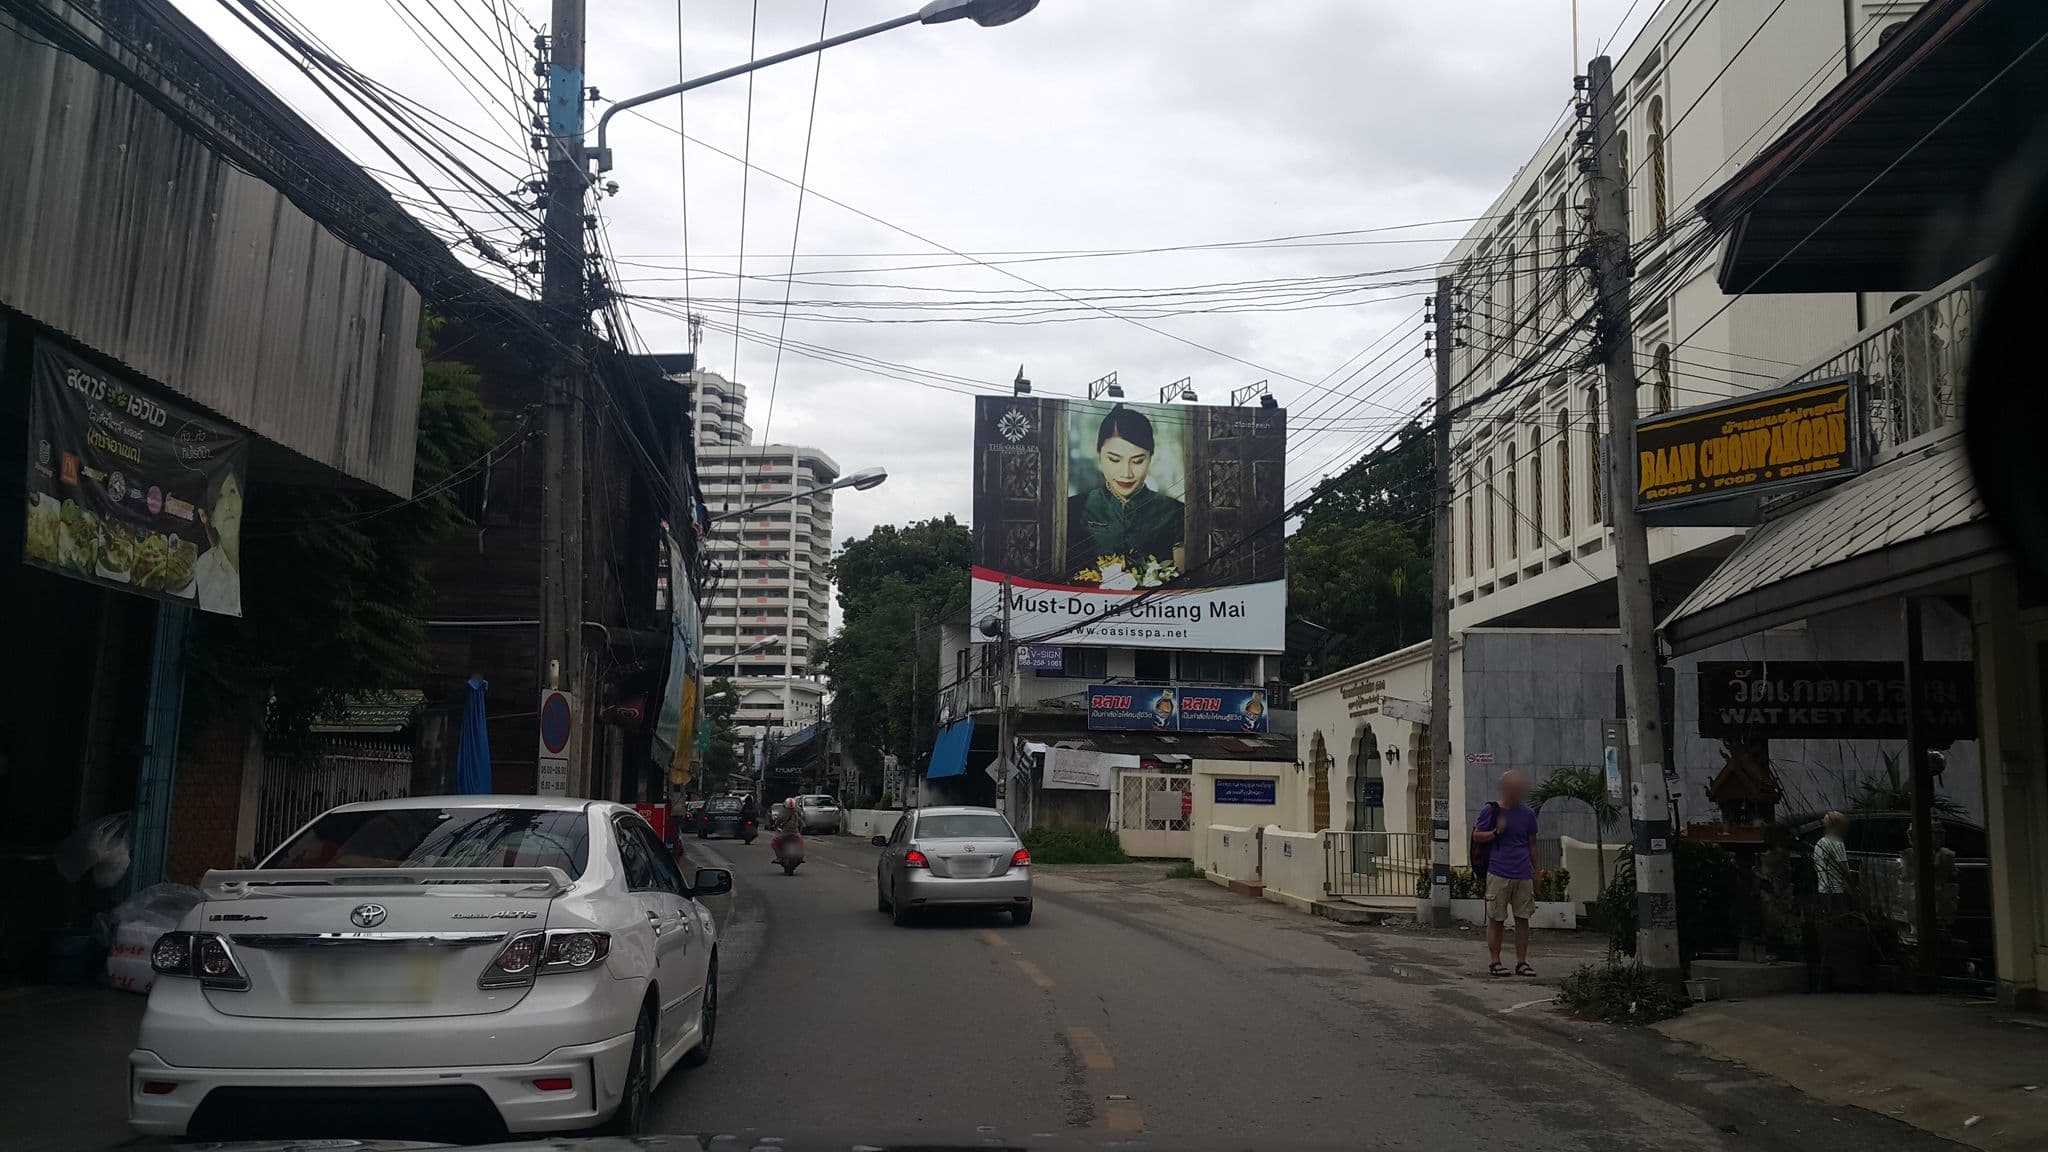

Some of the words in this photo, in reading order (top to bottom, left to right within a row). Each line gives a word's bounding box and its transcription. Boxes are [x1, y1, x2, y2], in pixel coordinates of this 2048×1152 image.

[988, 443, 1003, 451] THE
[1027, 445, 1040, 453] SPA
[1638, 442, 1697, 495] BAAN
[1700, 413, 1847, 478] CHONPAKORN
[1646, 484, 1692, 499] ROOM
[1713, 473, 1758, 488] FOOD
[1779, 458, 1841, 477] DRINK
[1009, 594, 1096, 617] Must-Do
[1104, 599, 1121, 617] in
[1130, 600, 1202, 622] Chiang
[1209, 600, 1246, 618] Mai
[1092, 694, 1132, 709] ฉลาม
[1181, 697, 1222, 711] ฉลาม
[1720, 707, 1783, 725] WAT
[1788, 707, 1848, 725] KET
